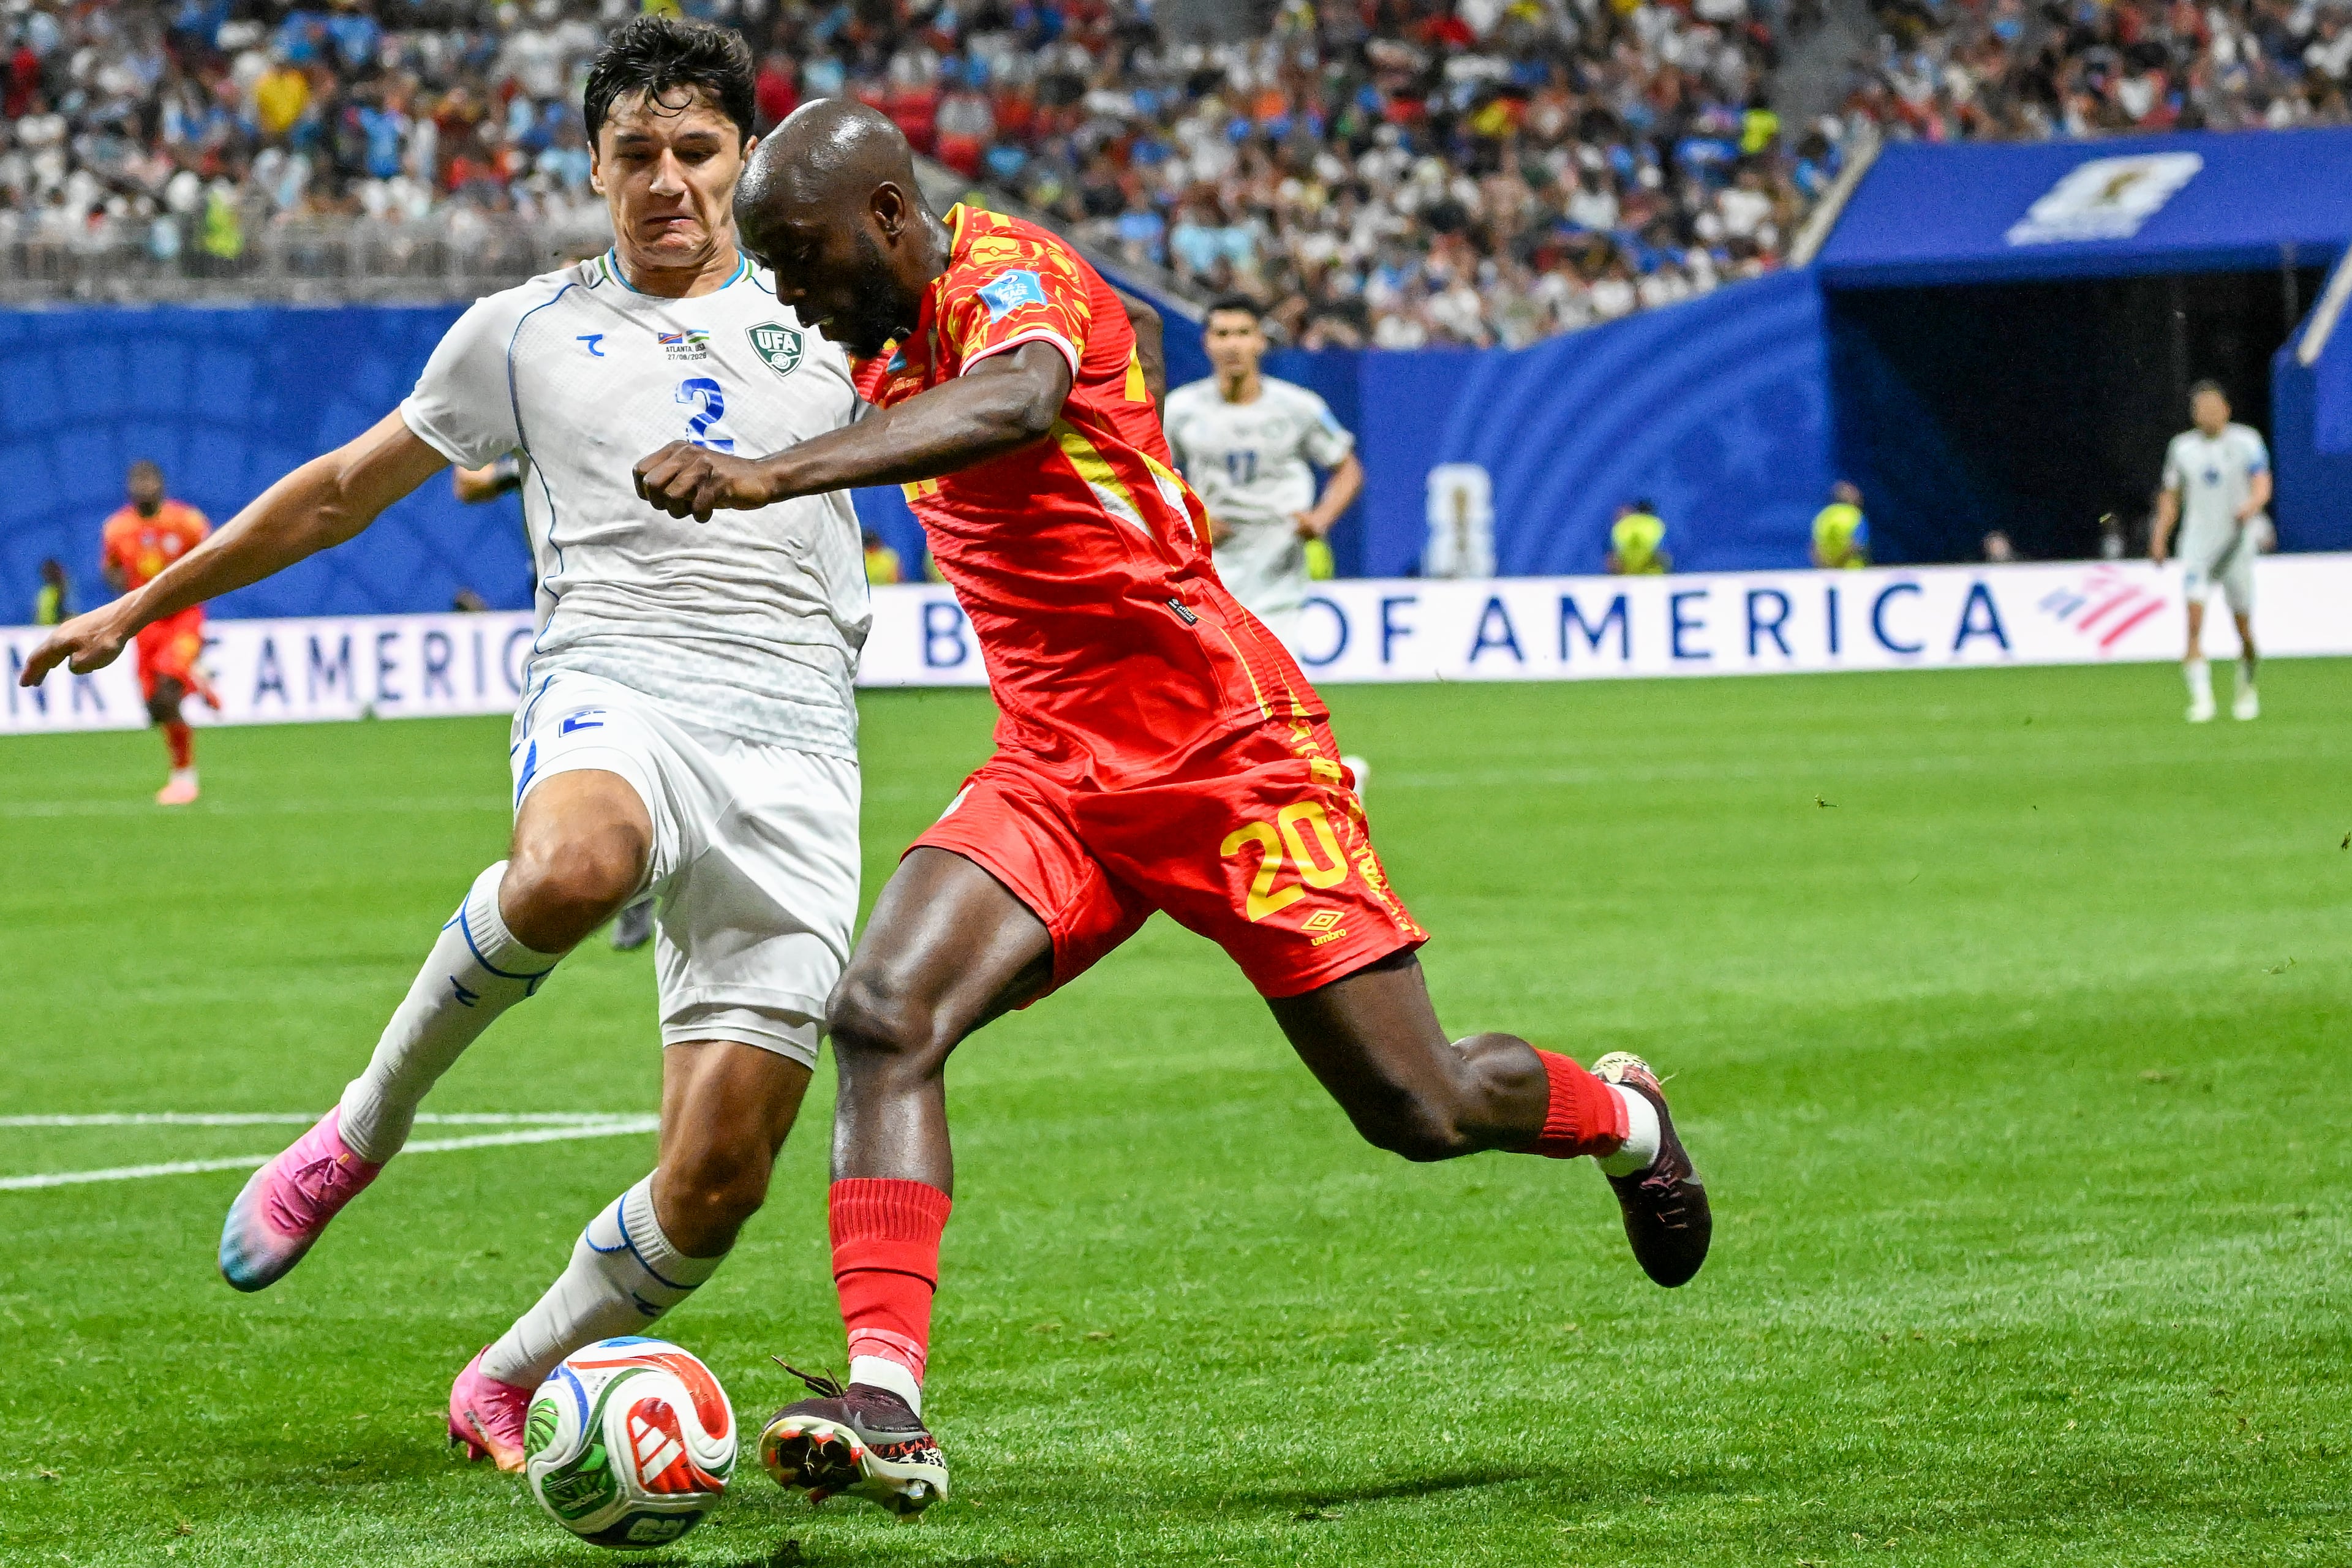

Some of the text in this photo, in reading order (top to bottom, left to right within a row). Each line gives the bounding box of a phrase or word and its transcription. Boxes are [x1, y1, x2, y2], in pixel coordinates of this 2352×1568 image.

[695, 343, 706, 352] USA
[757, 331, 798, 353] UFA
[676, 377, 734, 452] 2
[1300, 596, 1416, 665] OF
[1468, 581, 2010, 663] AMERICA
[1221, 801, 1348, 923] 20
[1311, 927, 1347, 947] umbro
